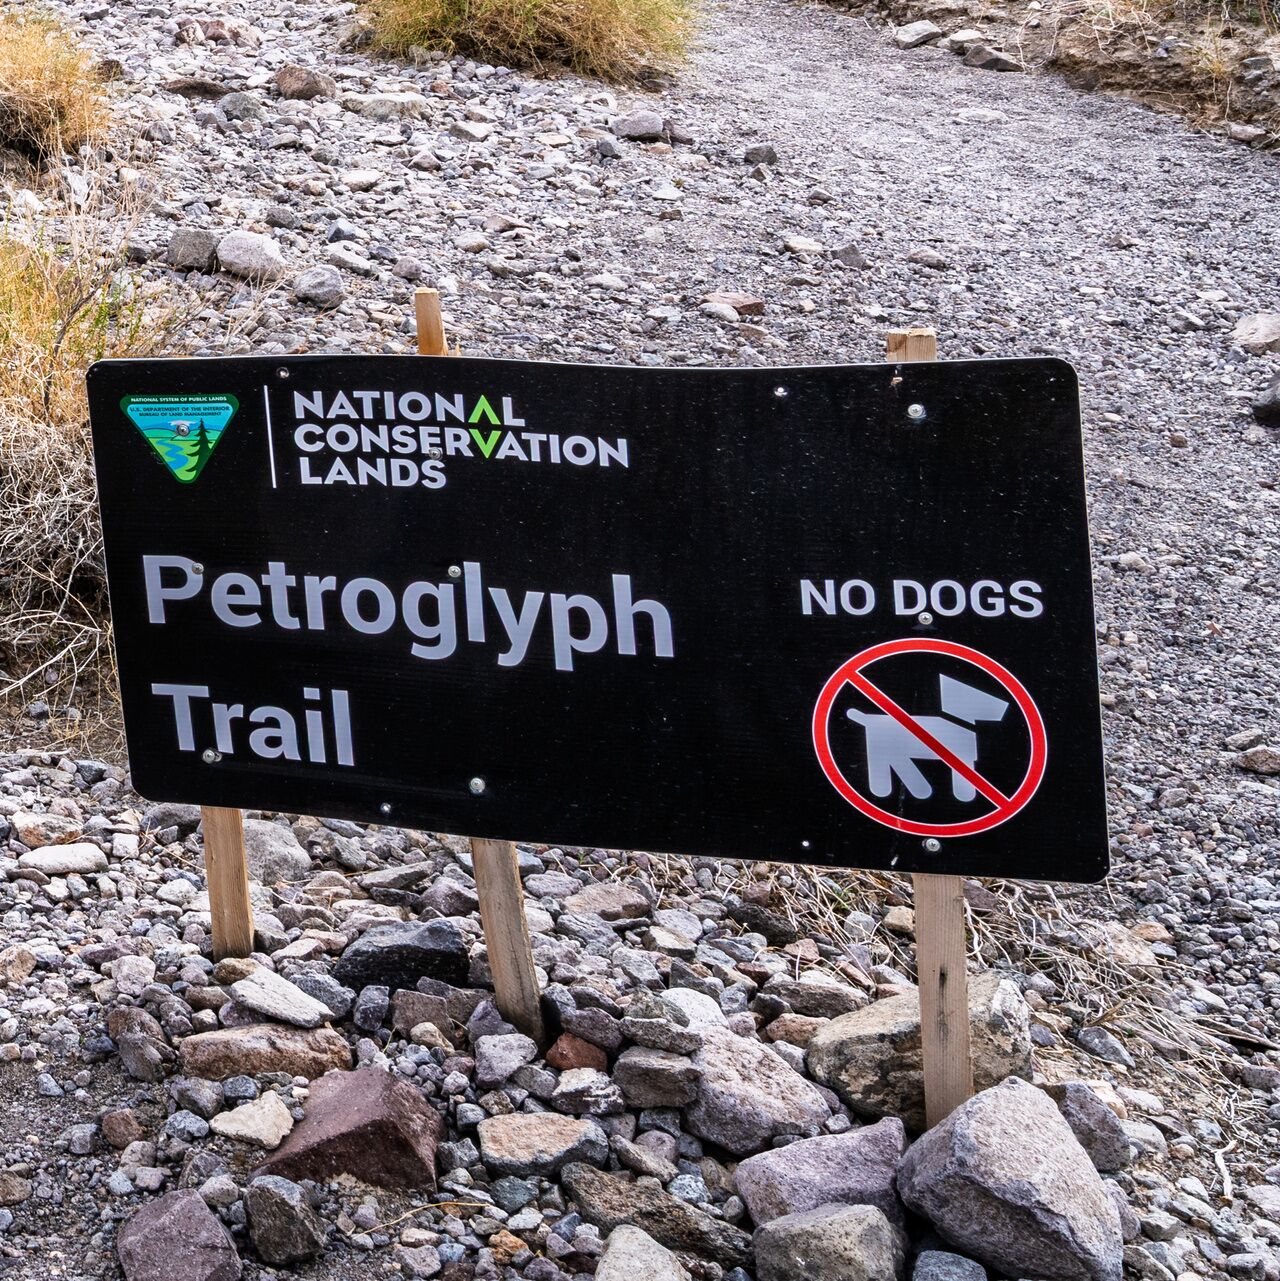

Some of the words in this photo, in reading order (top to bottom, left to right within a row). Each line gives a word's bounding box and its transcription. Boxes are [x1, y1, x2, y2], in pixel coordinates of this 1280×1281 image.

[294, 390, 526, 427] NATIONAL
[294, 423, 629, 469] CONSERVATION
[299, 456, 447, 490] LANDS
[142, 554, 675, 672] Petroglyph
[799, 578, 876, 616] NO
[892, 578, 1044, 618] DOGS
[151, 682, 355, 767] Trail
